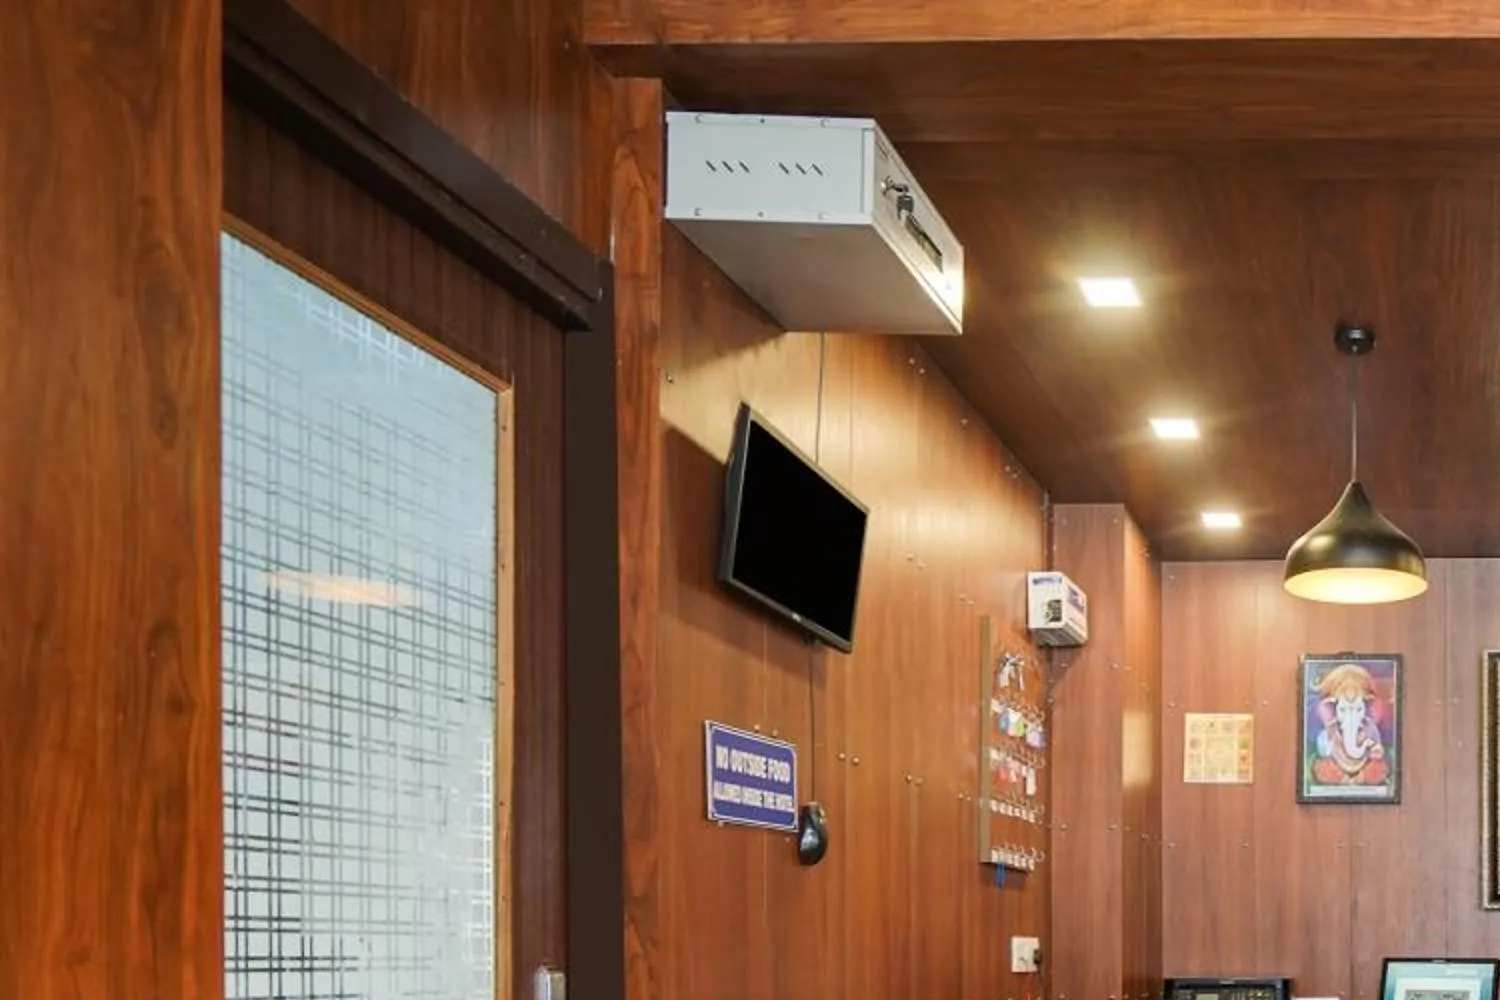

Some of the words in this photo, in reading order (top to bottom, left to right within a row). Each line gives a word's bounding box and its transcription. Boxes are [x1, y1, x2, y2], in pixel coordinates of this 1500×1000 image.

[715, 745, 729, 770] NO
[730, 748, 767, 779] OUTSIDE
[767, 757, 791, 784] FOOD
